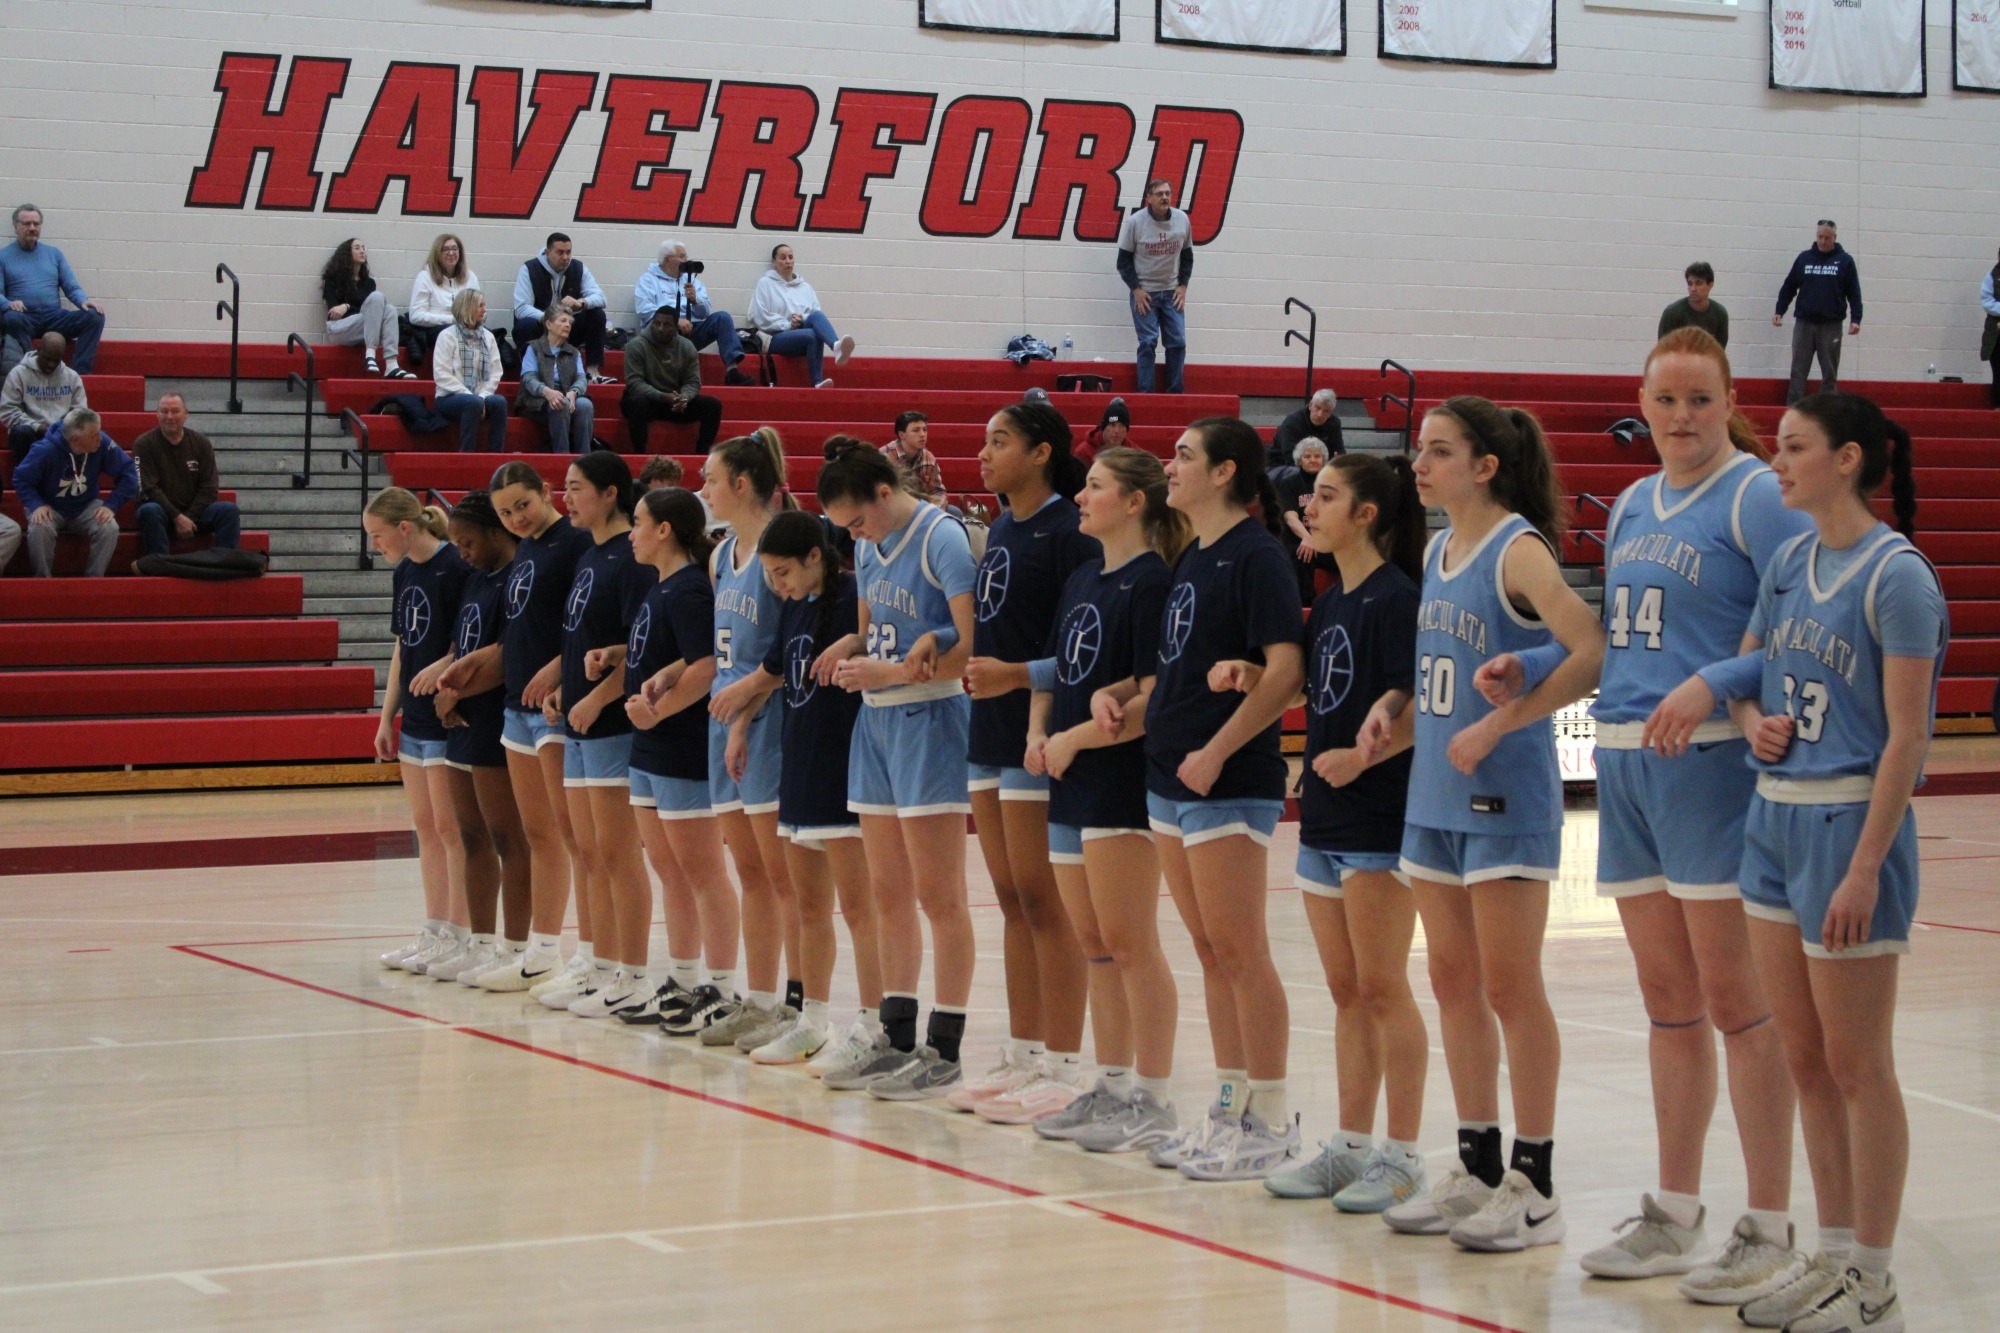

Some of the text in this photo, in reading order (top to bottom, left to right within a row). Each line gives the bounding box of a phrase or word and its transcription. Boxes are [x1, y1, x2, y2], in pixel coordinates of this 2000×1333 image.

[1178, 4, 1200, 14] 2008
[1399, 6, 1420, 16] 2007
[1398, 20, 1420, 30] 2008
[1784, 26, 1805, 35] 2014
[1784, 40, 1805, 50] 2016
[184, 51, 1244, 246] HAVERFORD
[1610, 584, 1665, 651] 44
[716, 627, 734, 670] 5
[867, 622, 900, 664] 22
[1419, 653, 1456, 717] 30
